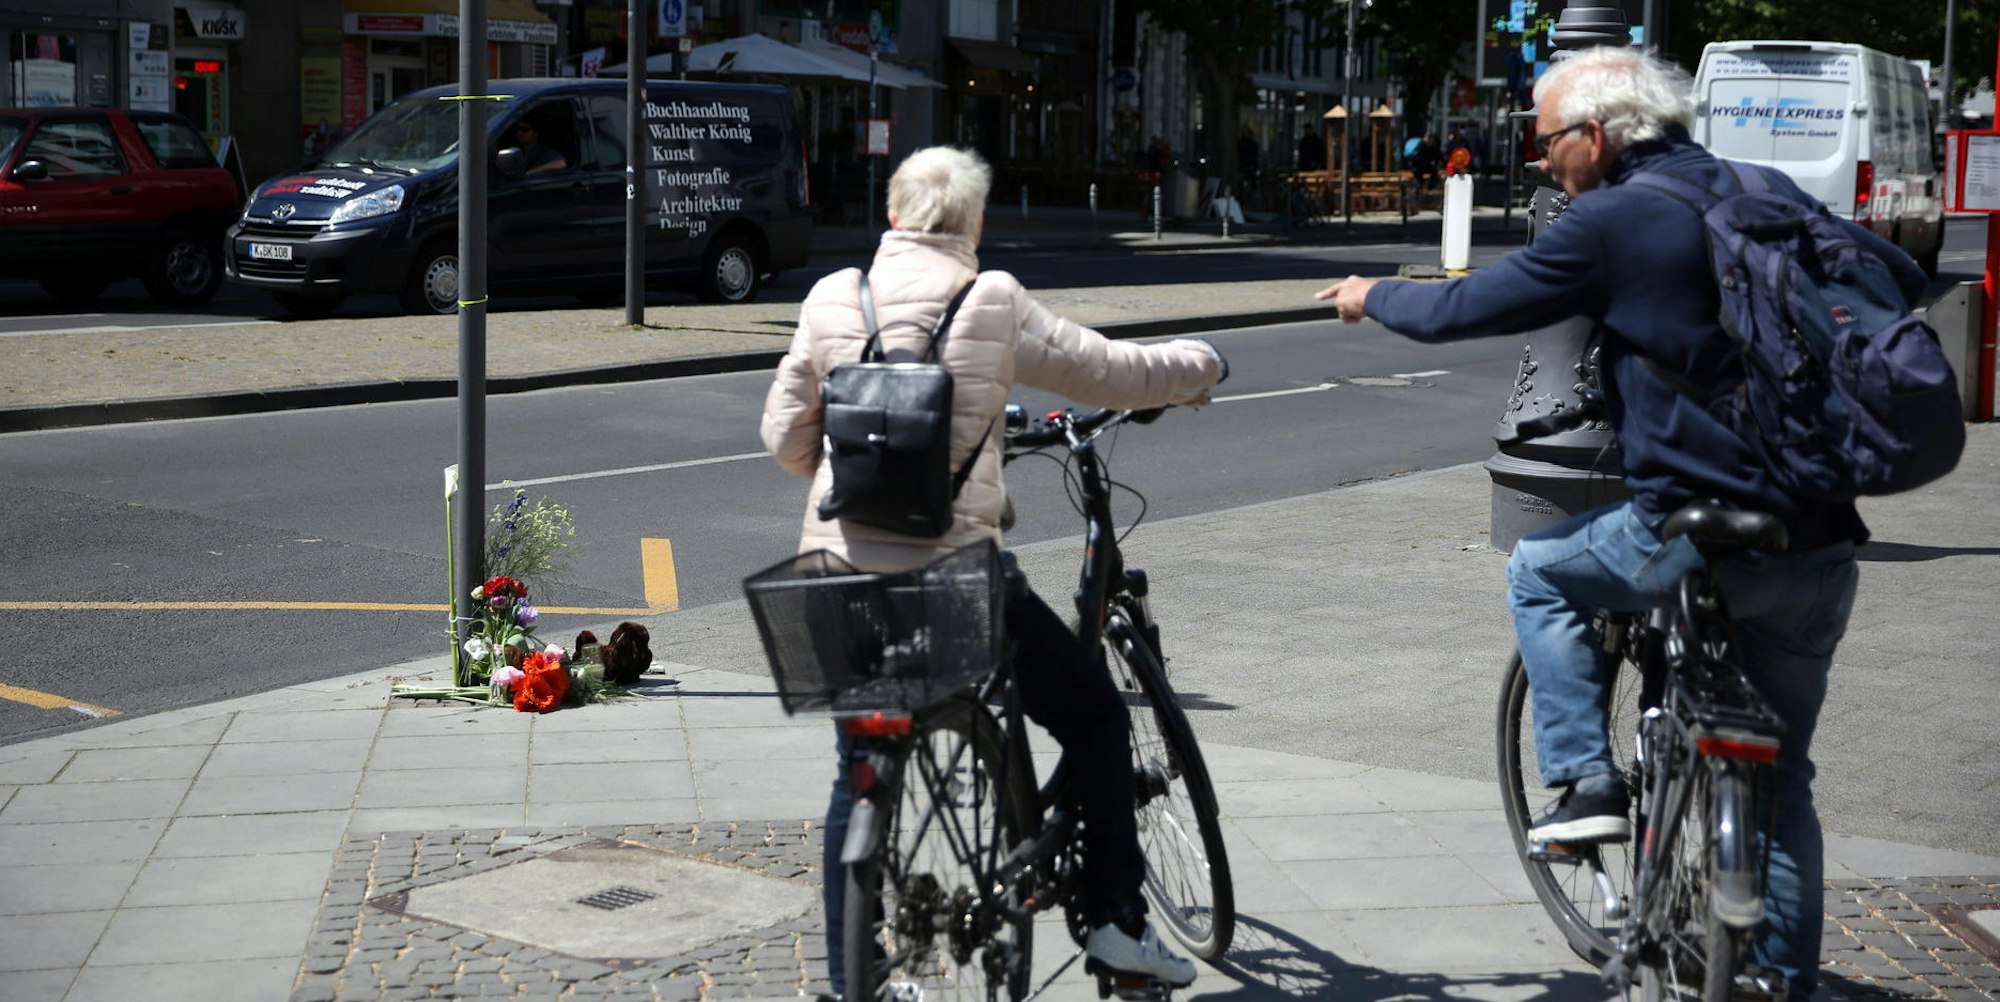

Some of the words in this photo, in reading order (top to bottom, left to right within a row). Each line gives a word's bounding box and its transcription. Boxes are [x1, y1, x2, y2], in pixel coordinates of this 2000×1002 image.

[202, 19, 237, 36] KIOSK
[646, 101, 750, 123] Buchhandlung
[648, 122, 706, 140] Walther
[708, 123, 752, 144] König
[1770, 129, 1806, 137] System
[1807, 129, 1837, 137] GmbH
[652, 146, 695, 161] Kunst
[657, 167, 730, 190] Fotografie
[658, 195, 743, 215] Architektur
[660, 216, 707, 238] Design
